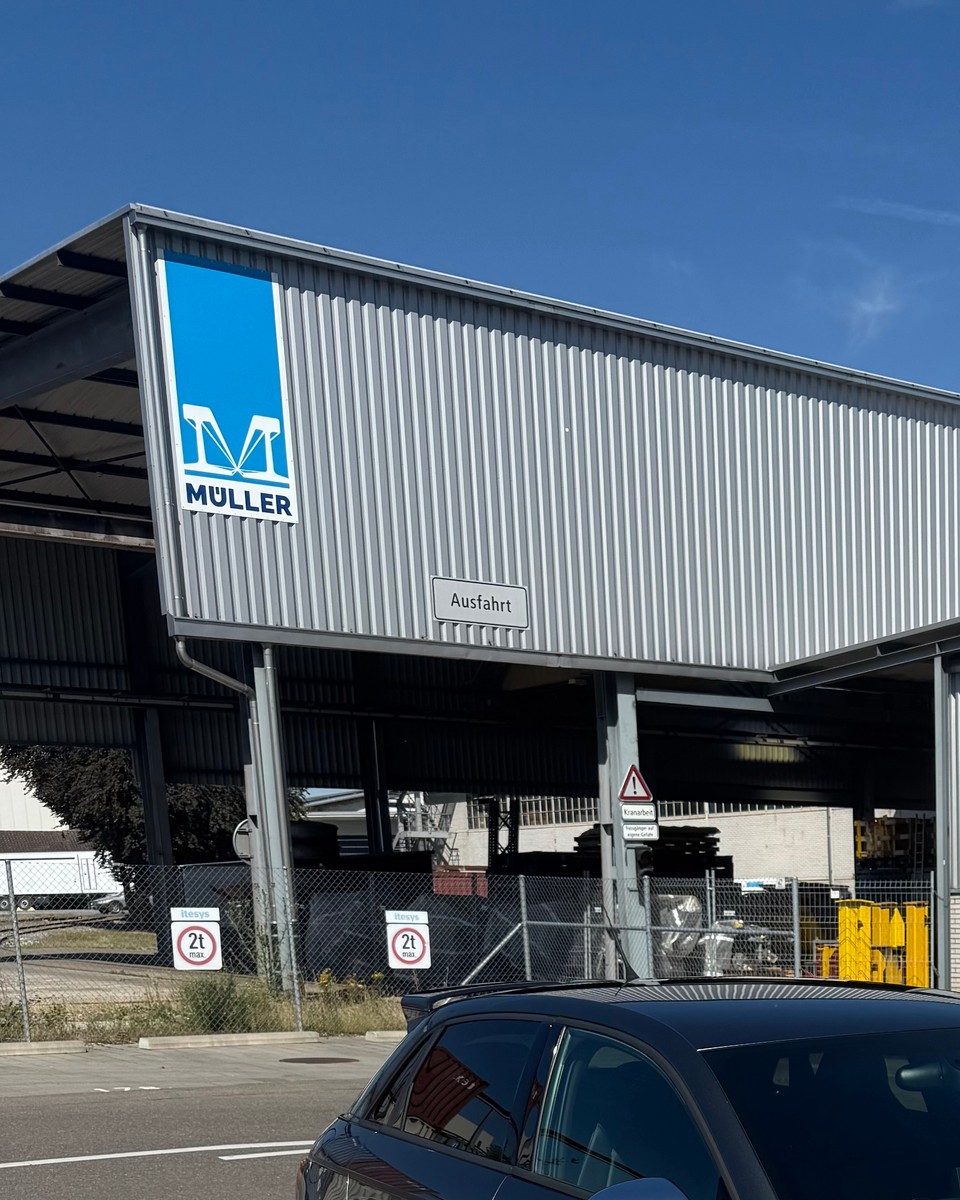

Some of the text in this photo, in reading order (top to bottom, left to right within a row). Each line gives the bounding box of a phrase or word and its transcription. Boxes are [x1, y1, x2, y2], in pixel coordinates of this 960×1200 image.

[185, 482, 292, 516] MÜLLER
[450, 593, 512, 613] Ausfahrt
[181, 909, 210, 919] itesys
[188, 932, 206, 950] 2t
[401, 933, 417, 950] 2t
